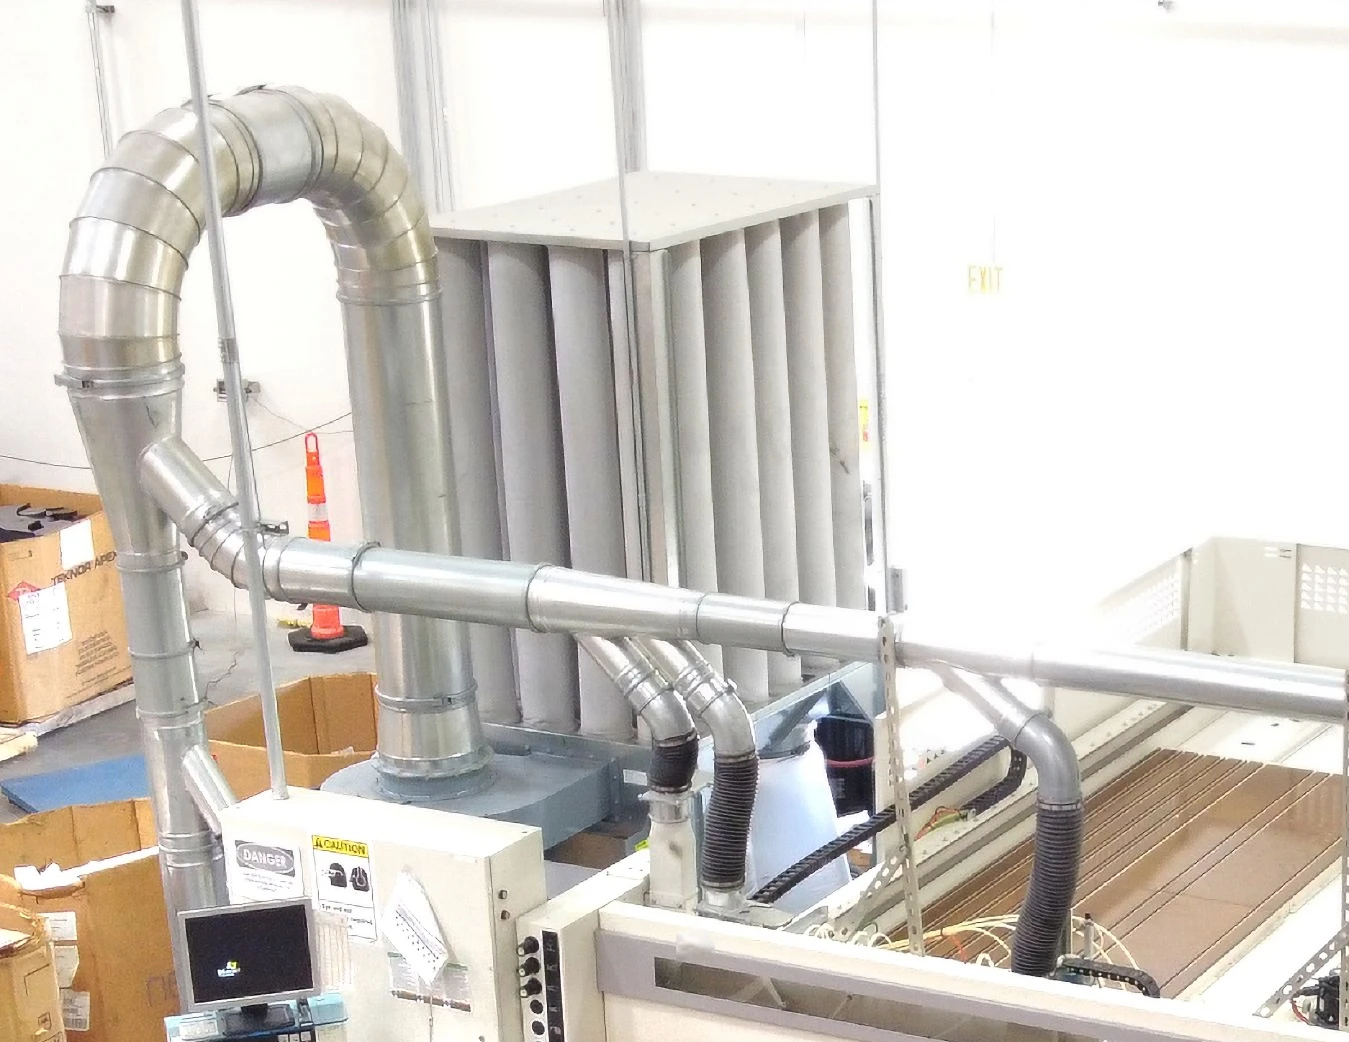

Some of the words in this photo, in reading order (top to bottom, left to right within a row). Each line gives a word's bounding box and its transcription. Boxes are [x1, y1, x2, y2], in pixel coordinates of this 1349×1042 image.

[968, 265, 1003, 294] EXIT
[324, 839, 366, 855] CAUTION
[243, 848, 287, 868] DANGER
